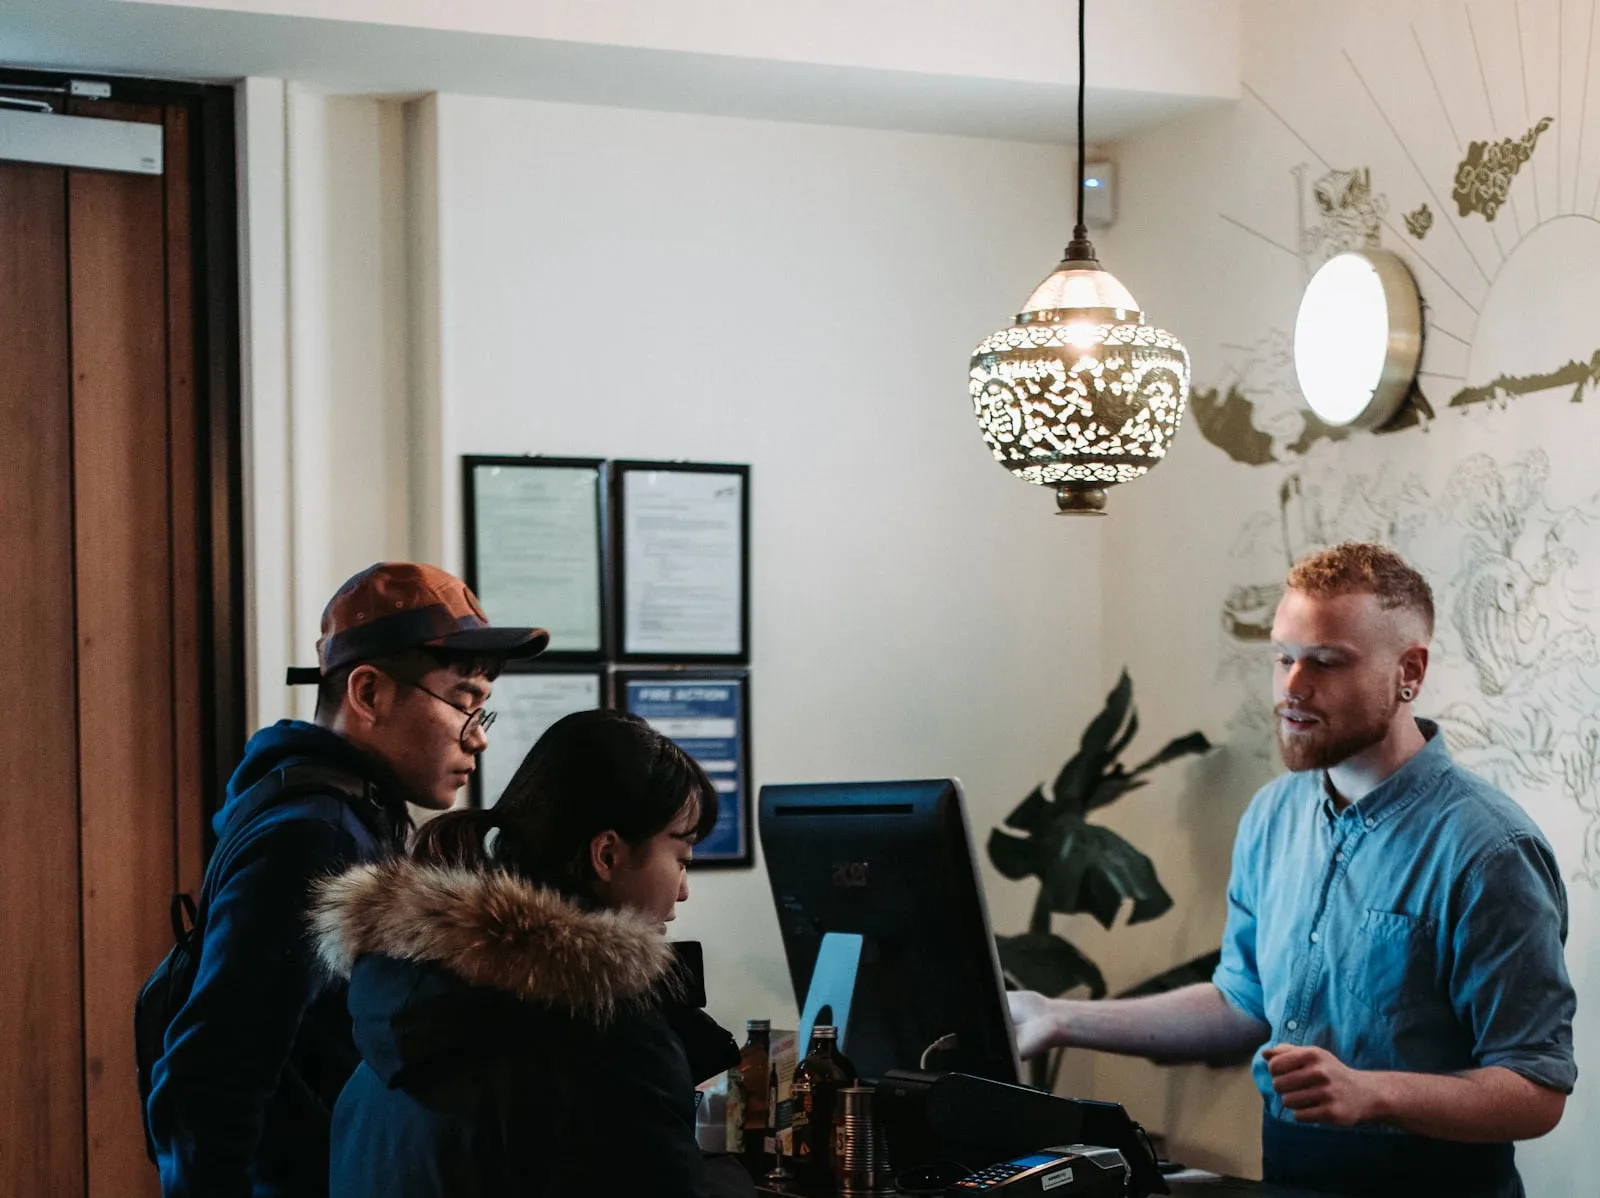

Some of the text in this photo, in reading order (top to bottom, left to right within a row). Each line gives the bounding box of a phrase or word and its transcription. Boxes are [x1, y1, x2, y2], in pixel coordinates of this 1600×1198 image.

[639, 687, 729, 701] FIRE ACTION
[830, 860, 866, 887] acer
